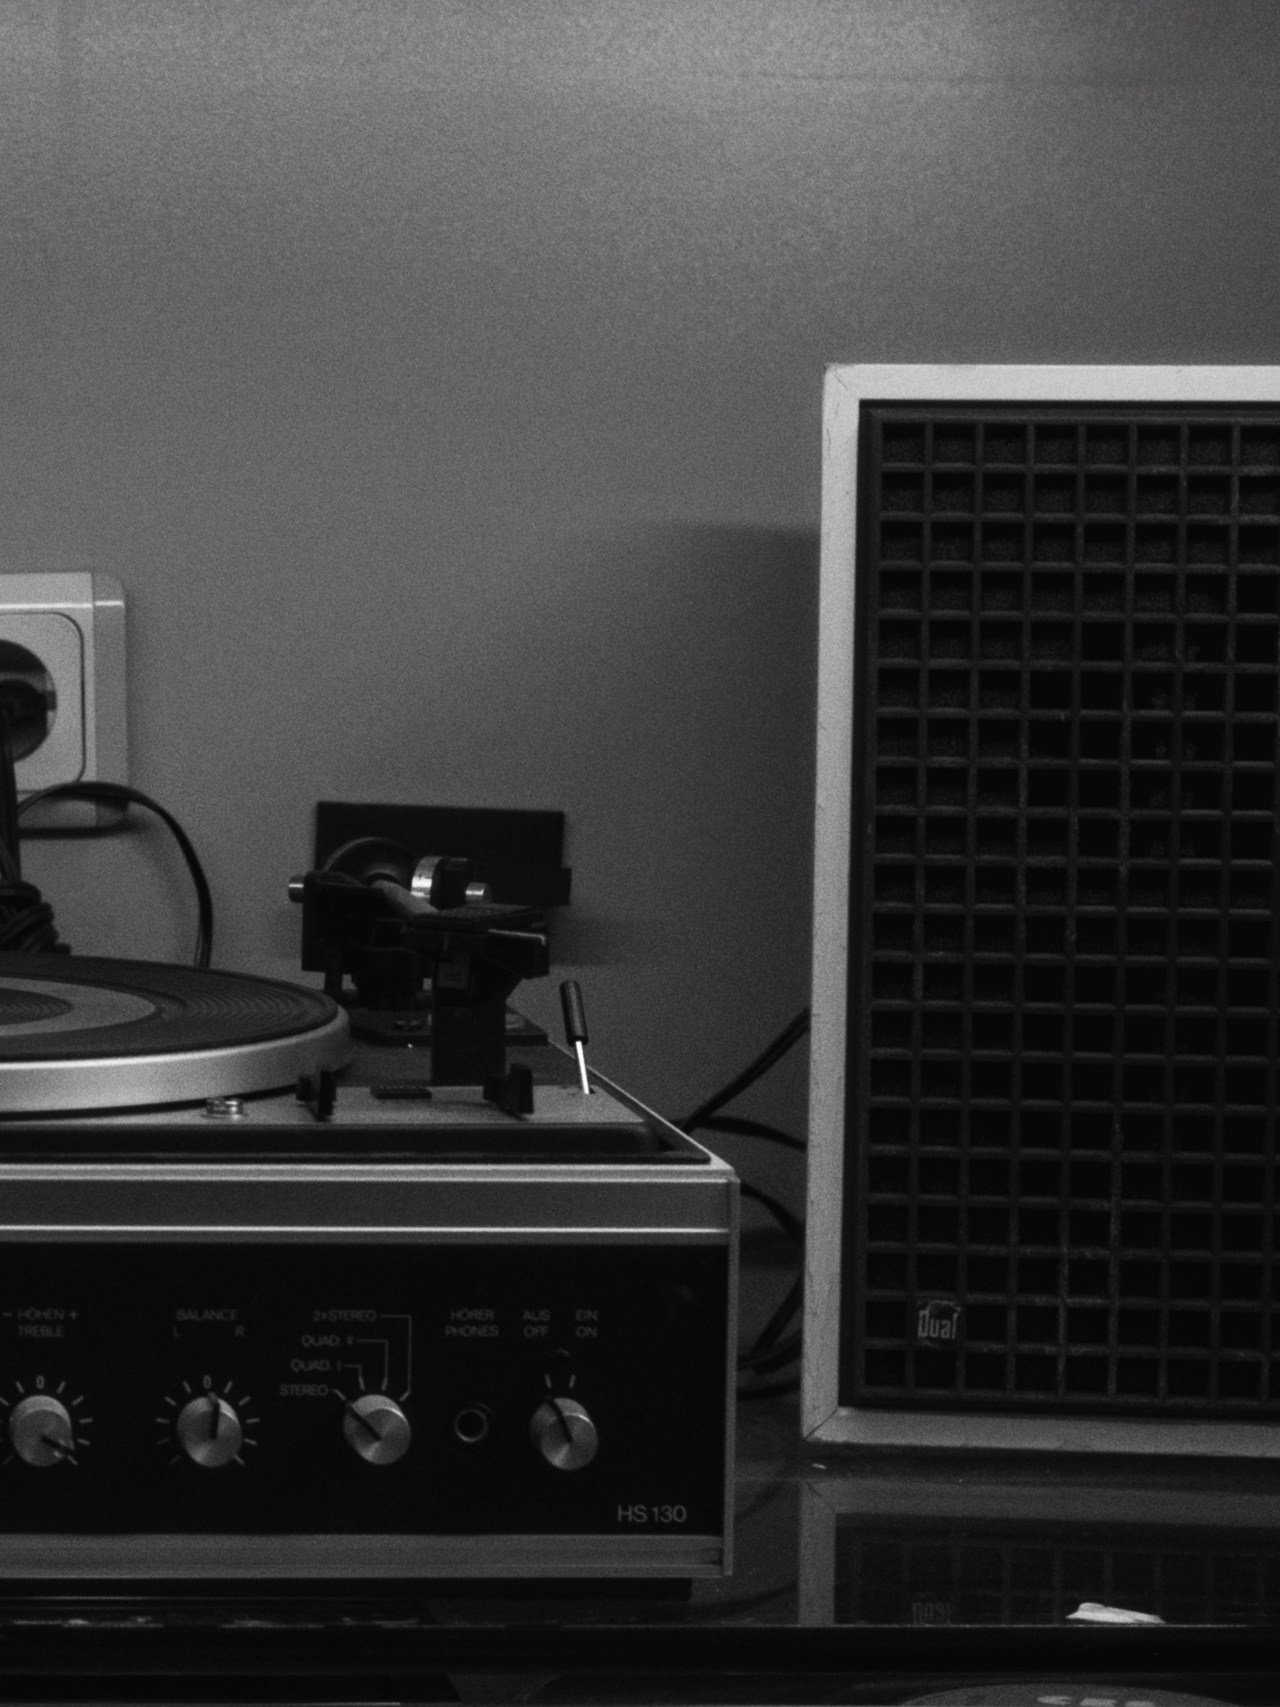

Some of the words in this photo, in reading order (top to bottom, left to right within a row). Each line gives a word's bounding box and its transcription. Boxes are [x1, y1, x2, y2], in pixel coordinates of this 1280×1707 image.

[17, 1307, 64, 1320] HÖHEN
[176, 1309, 238, 1320] BALANCE
[450, 1308, 495, 1321] HÖRER
[523, 1310, 550, 1322] AUS
[575, 1310, 598, 1322] EIN
[18, 1325, 63, 1337] TREBLE
[173, 1326, 181, 1338] L
[235, 1326, 245, 1338] R
[445, 1325, 499, 1338] PHONES
[523, 1325, 550, 1338] OFF
[576, 1325, 597, 1338] ON
[279, 1384, 328, 1397] STEREO
[617, 1504, 648, 1523] HS
[651, 1505, 687, 1523] 130
